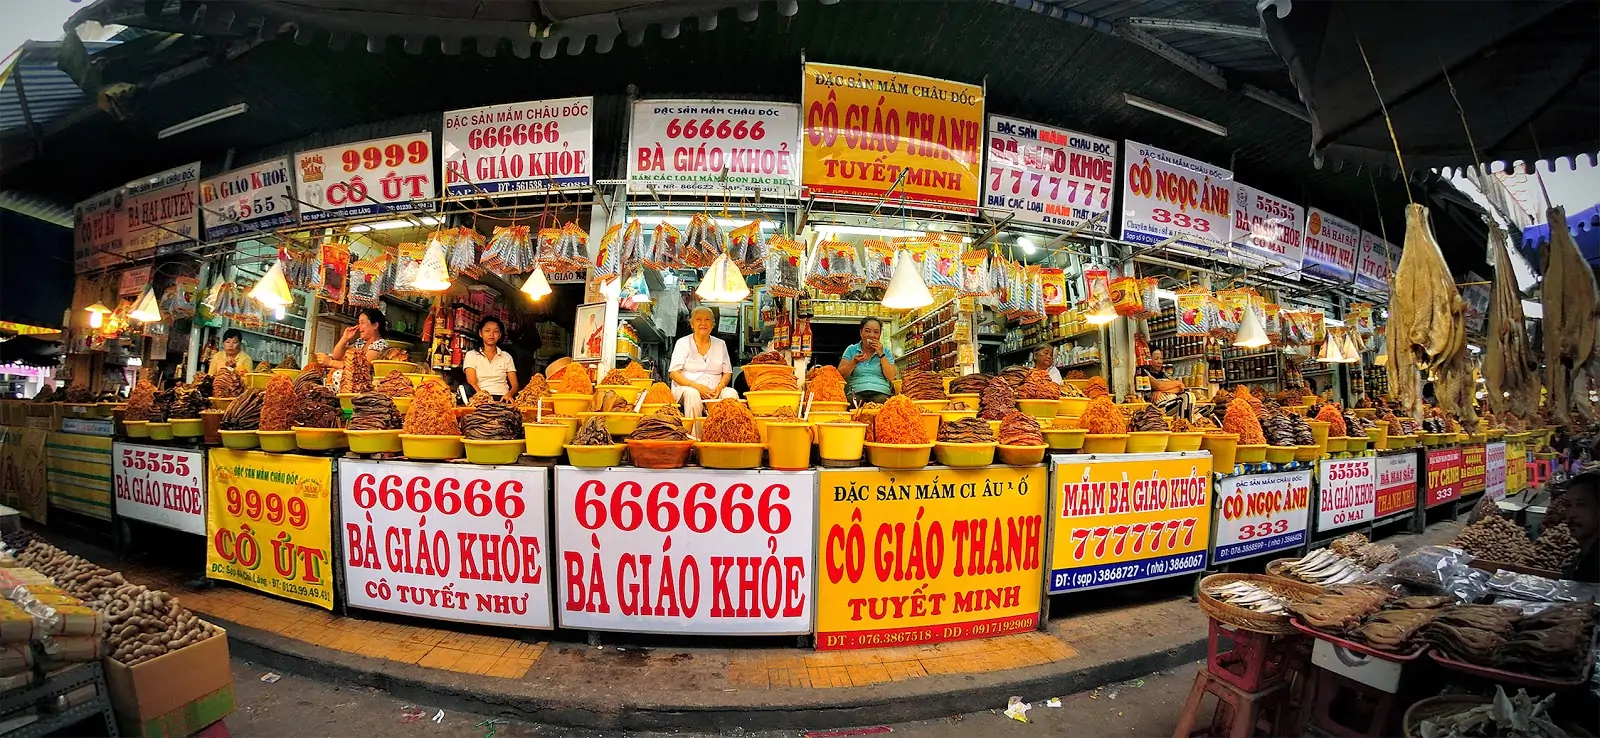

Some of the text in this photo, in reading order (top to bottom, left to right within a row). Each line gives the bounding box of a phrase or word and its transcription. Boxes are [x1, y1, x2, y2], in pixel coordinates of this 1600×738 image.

[815, 72, 976, 108] ĐẶC SẢN MẮM CHÂU ĐỐC
[446, 100, 589, 132] ĐẶC SẢN MẮM CHÂU ĐỐC
[653, 106, 674, 116] ĐẶC
[677, 105, 699, 115] SẢN
[728, 107, 756, 116] CHÂU
[759, 107, 780, 117] ĐỐC
[467, 120, 561, 151] 666666
[666, 118, 766, 140] 666666
[807, 90, 980, 166] CÔ GIÁO THANH
[341, 141, 430, 174] 9999
[447, 153, 471, 184] BÀ
[476, 148, 524, 182] GIÁO
[637, 142, 666, 172] BÀ
[673, 142, 724, 172] GIÁO
[203, 184, 219, 204] BÀ
[220, 176, 249, 199] GIÁO
[326, 170, 430, 208] CÔ ÚT
[824, 156, 962, 192] TUYẾT MINH
[989, 167, 1111, 211] 7777777
[1129, 157, 1154, 200] CÔ
[1155, 168, 1200, 213] NGỌC
[1151, 209, 1211, 233] 333
[1235, 206, 1250, 233] BÀ
[1255, 194, 1295, 222] 55555
[1268, 242, 1286, 254] MAI
[1305, 236, 1338, 264] THANH
[1321, 225, 1345, 244] BÀ HAI
[122, 449, 191, 477] 55555
[1328, 461, 1370, 482] 55555
[1380, 469, 1390, 487] BÀ
[1427, 466, 1440, 490] ÚT
[115, 468, 132, 501] BÀ
[132, 472, 160, 507] GIÁO
[352, 473, 526, 519] 666666
[833, 475, 955, 504] ĐẶC SẢN MẮM
[1062, 465, 1207, 518] MẮM BÀ GIÁO KHỎE
[1321, 482, 1333, 513] BÀ
[1334, 480, 1354, 511] GIÁO
[1376, 491, 1402, 513] THANH
[1436, 487, 1453, 501] 333
[226, 485, 310, 531] 9999
[574, 479, 792, 534] 666666
[1223, 488, 1244, 522] CÔ
[1246, 489, 1283, 520] NGỌC
[1333, 509, 1364, 525] CÔ MAI
[825, 505, 1042, 584] CÔ GIÁO THANH
[1070, 518, 1198, 561] 7777777
[1238, 519, 1289, 541] 333
[214, 522, 328, 587] CÔ ÚT
[346, 510, 542, 585] BÀ GIÁO KHỎE
[563, 532, 806, 619] BÀ GIÁO KHỎE
[1055, 554, 1204, 588] ĐT: 3868727 3866067
[365, 577, 530, 615] CÔ TUYẾT NHƯ
[847, 582, 1021, 622] TUYẾT MINH
[826, 617, 1034, 647] ĐT 076.3867518 DĐ 0917192909
